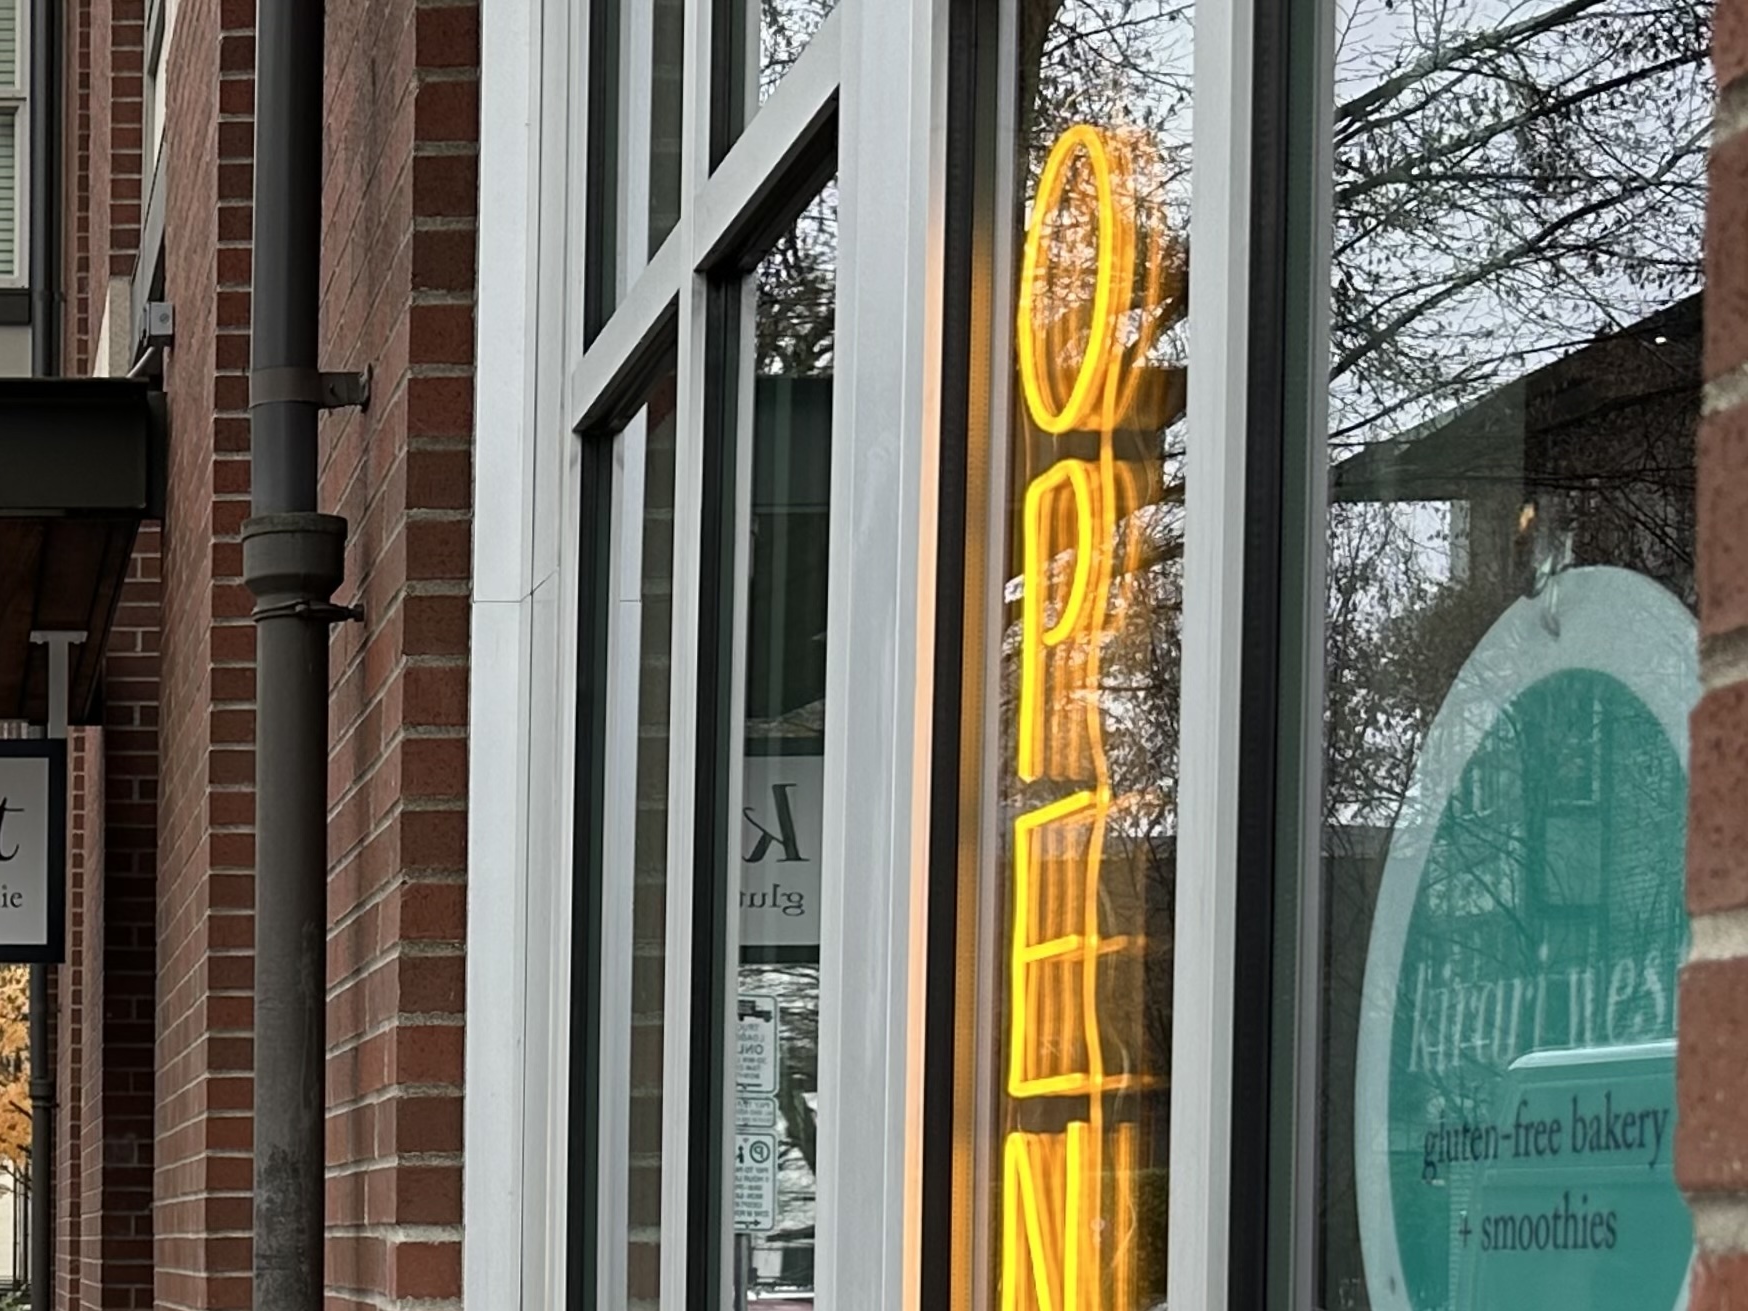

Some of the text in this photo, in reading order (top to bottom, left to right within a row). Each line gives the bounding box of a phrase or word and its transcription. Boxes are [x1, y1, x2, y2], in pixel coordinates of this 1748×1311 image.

[1422, 1090, 1669, 1184] gluten-free bakery
[1481, 1190, 1617, 1251] smoothies
